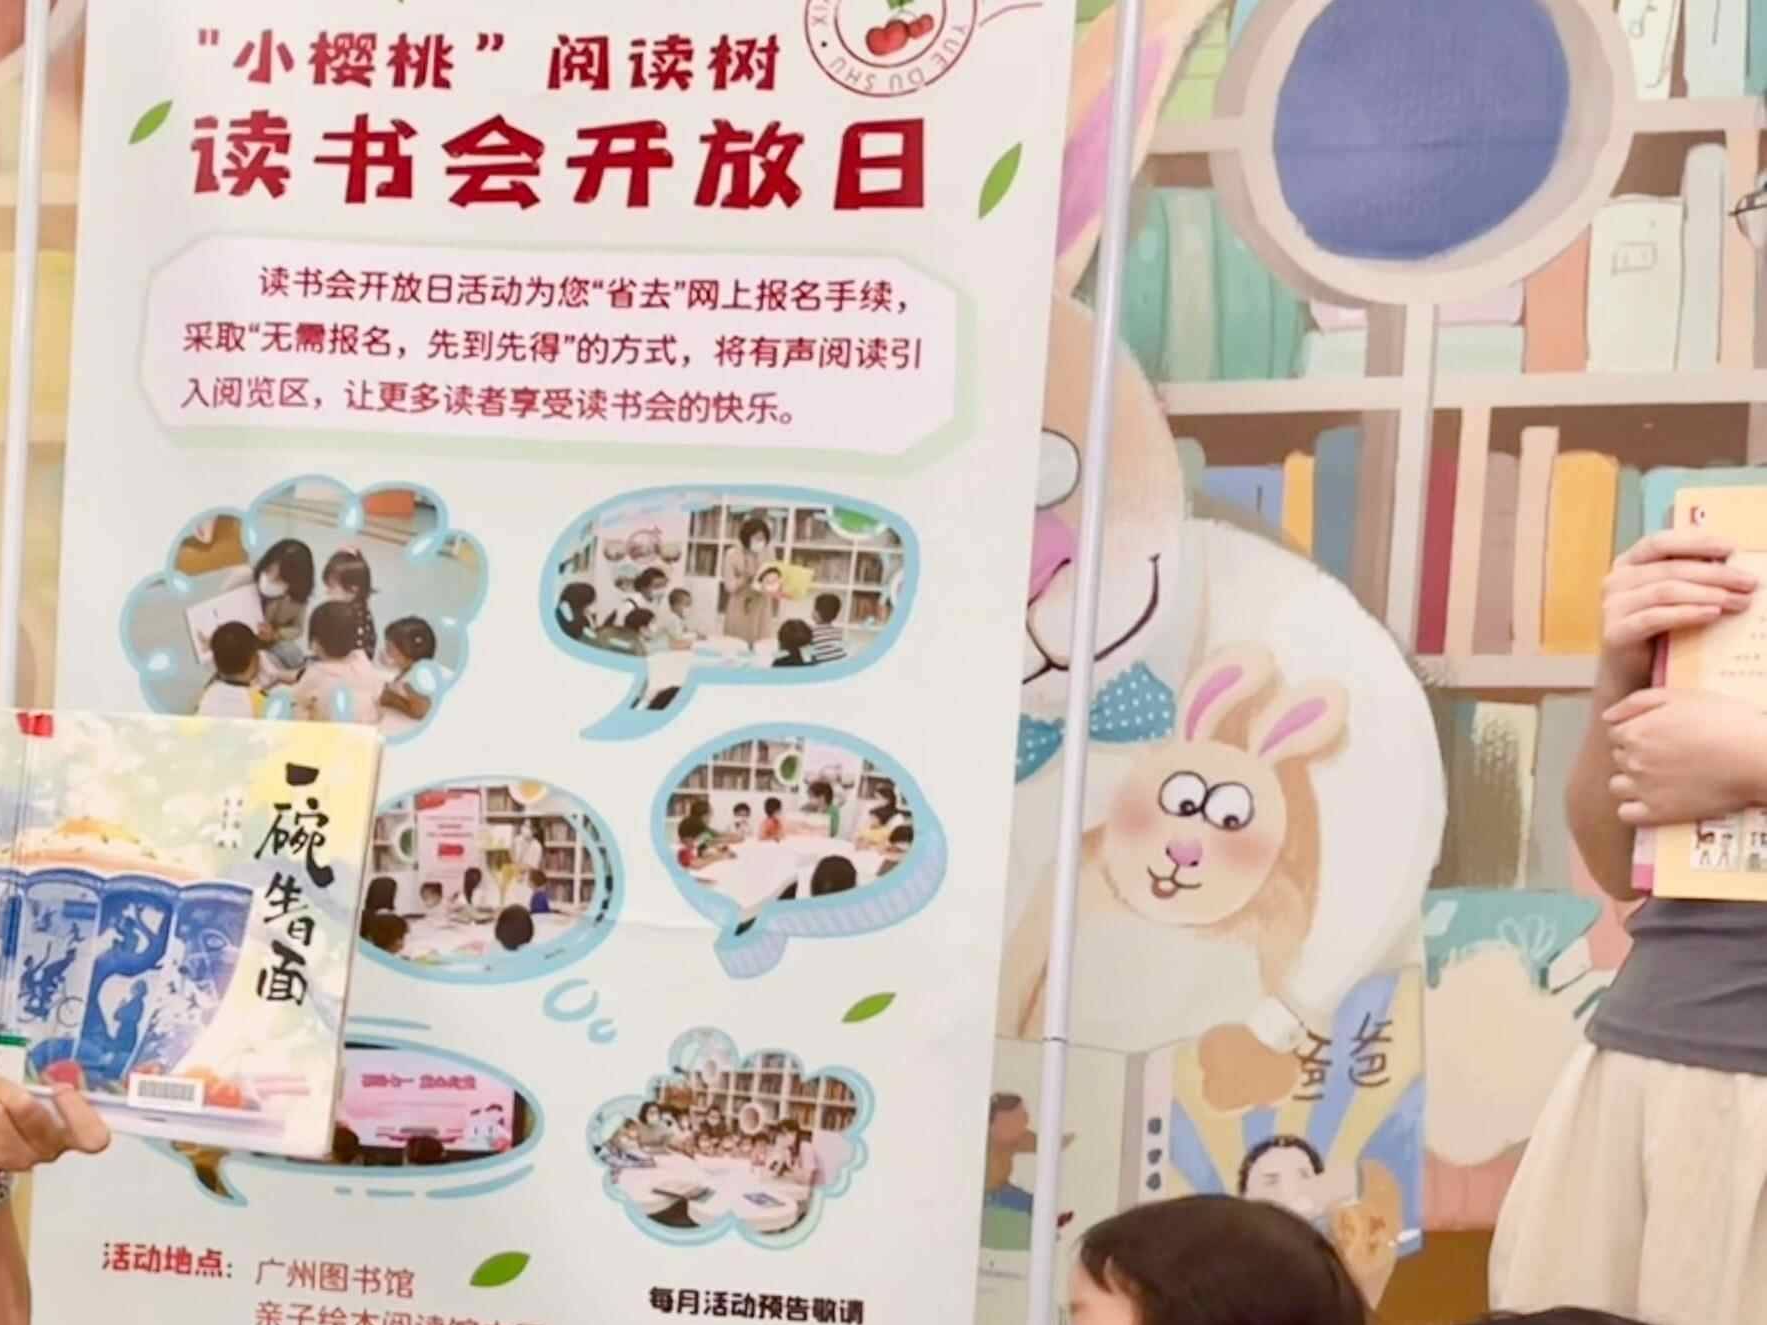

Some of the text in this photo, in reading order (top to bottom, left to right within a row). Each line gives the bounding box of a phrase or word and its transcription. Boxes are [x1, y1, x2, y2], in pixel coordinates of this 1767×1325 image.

[547, 34, 780, 91] 阅读树
[830, 57, 877, 91] SHU
[889, 67, 925, 91] DU
[191, 110, 925, 210] 读书会开放日
[180, 376, 793, 425] 入阅览区，让更多读者享受读书会的快乐。
[102, 1242, 416, 1300] 活动地点： 广州图书馆
[649, 1286, 865, 1325] 每月活动预告敬请
